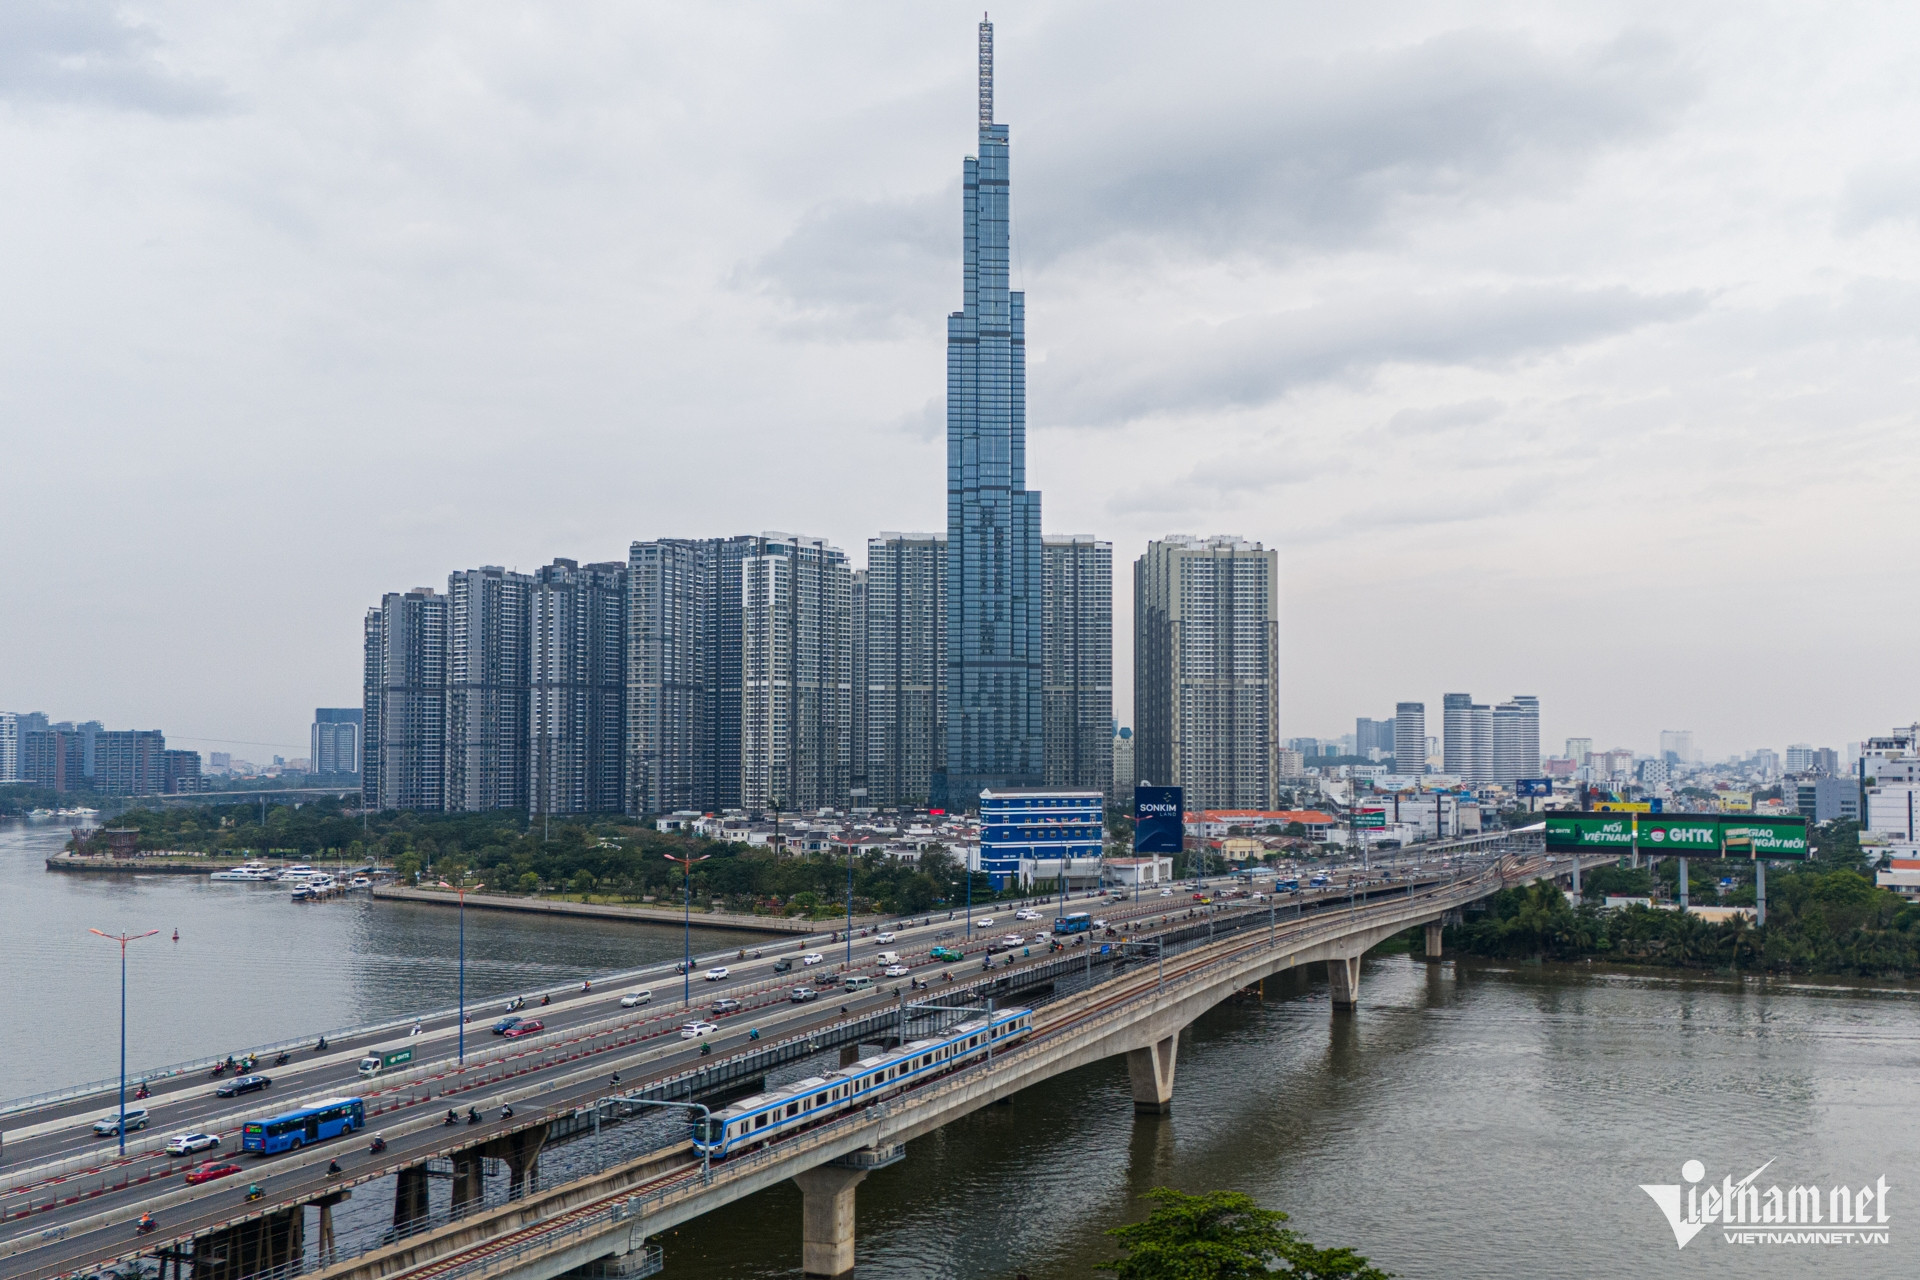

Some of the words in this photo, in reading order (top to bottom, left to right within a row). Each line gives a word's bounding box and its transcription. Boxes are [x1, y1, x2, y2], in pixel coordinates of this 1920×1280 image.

[1603, 821, 1623, 833] NỐI
[1669, 828, 1713, 843] GHTK
[1748, 828, 1774, 838] GIAO
[1754, 837, 1783, 848] NGÀY
